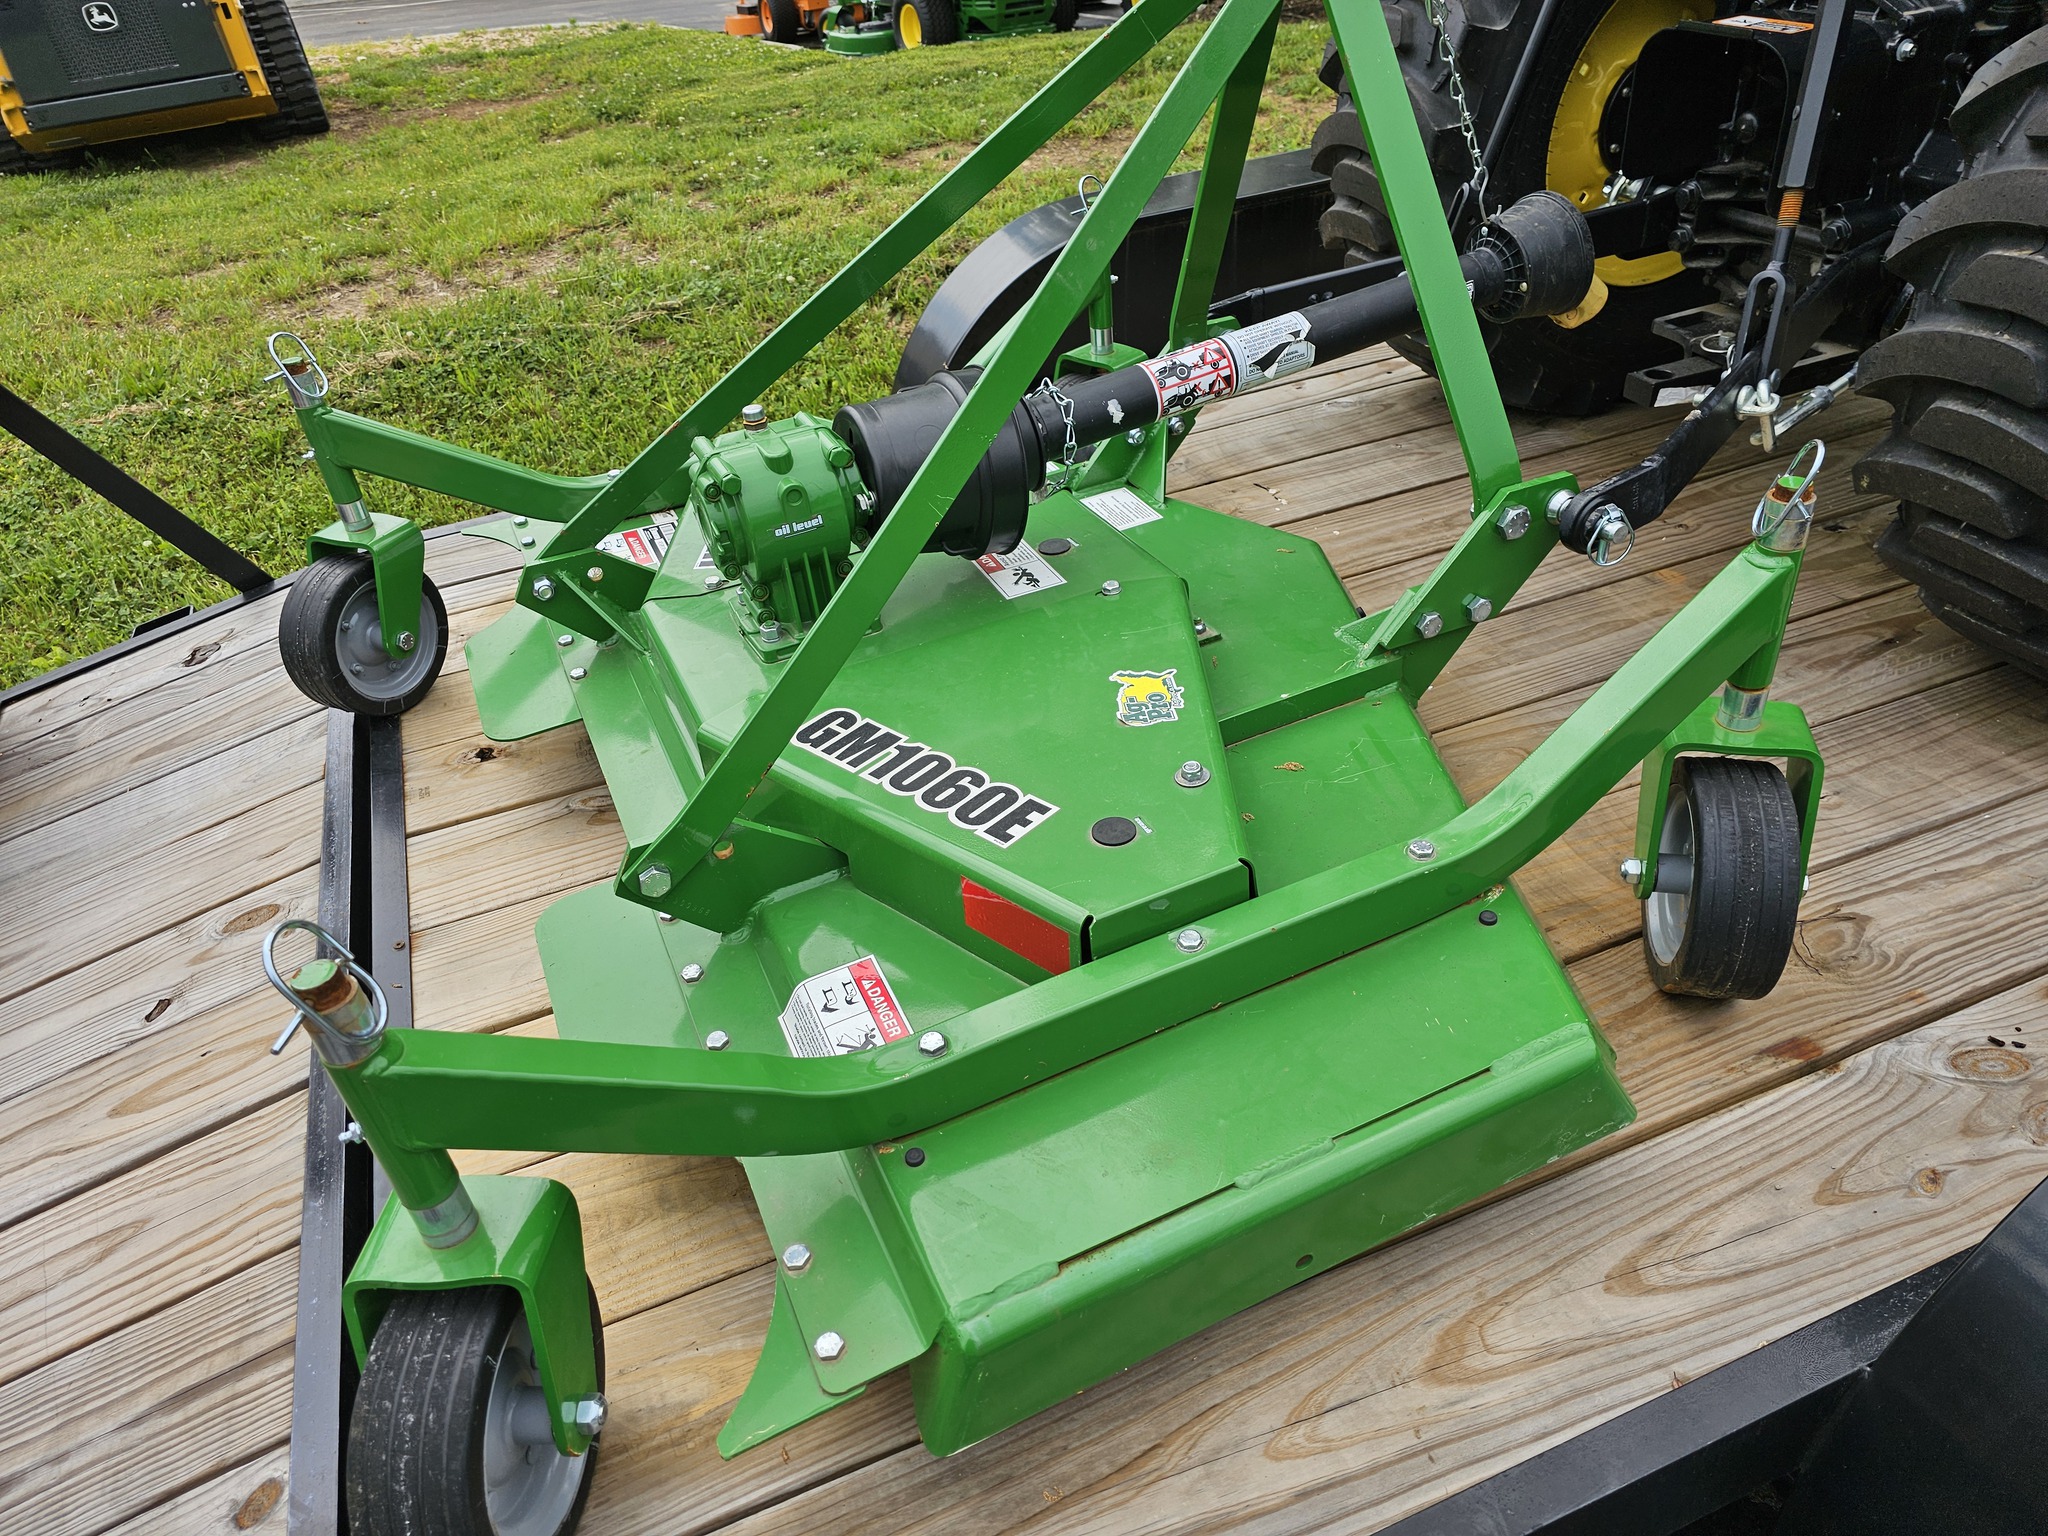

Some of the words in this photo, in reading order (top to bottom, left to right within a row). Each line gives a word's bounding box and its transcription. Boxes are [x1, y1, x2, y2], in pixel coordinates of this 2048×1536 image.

[775, 524, 790, 537] oil
[792, 515, 823, 532] level
[1122, 697, 1150, 723] Ag-
[1147, 693, 1174, 720] Pro
[795, 710, 1053, 844] GM1060E
[867, 988, 902, 1038] DANGER
